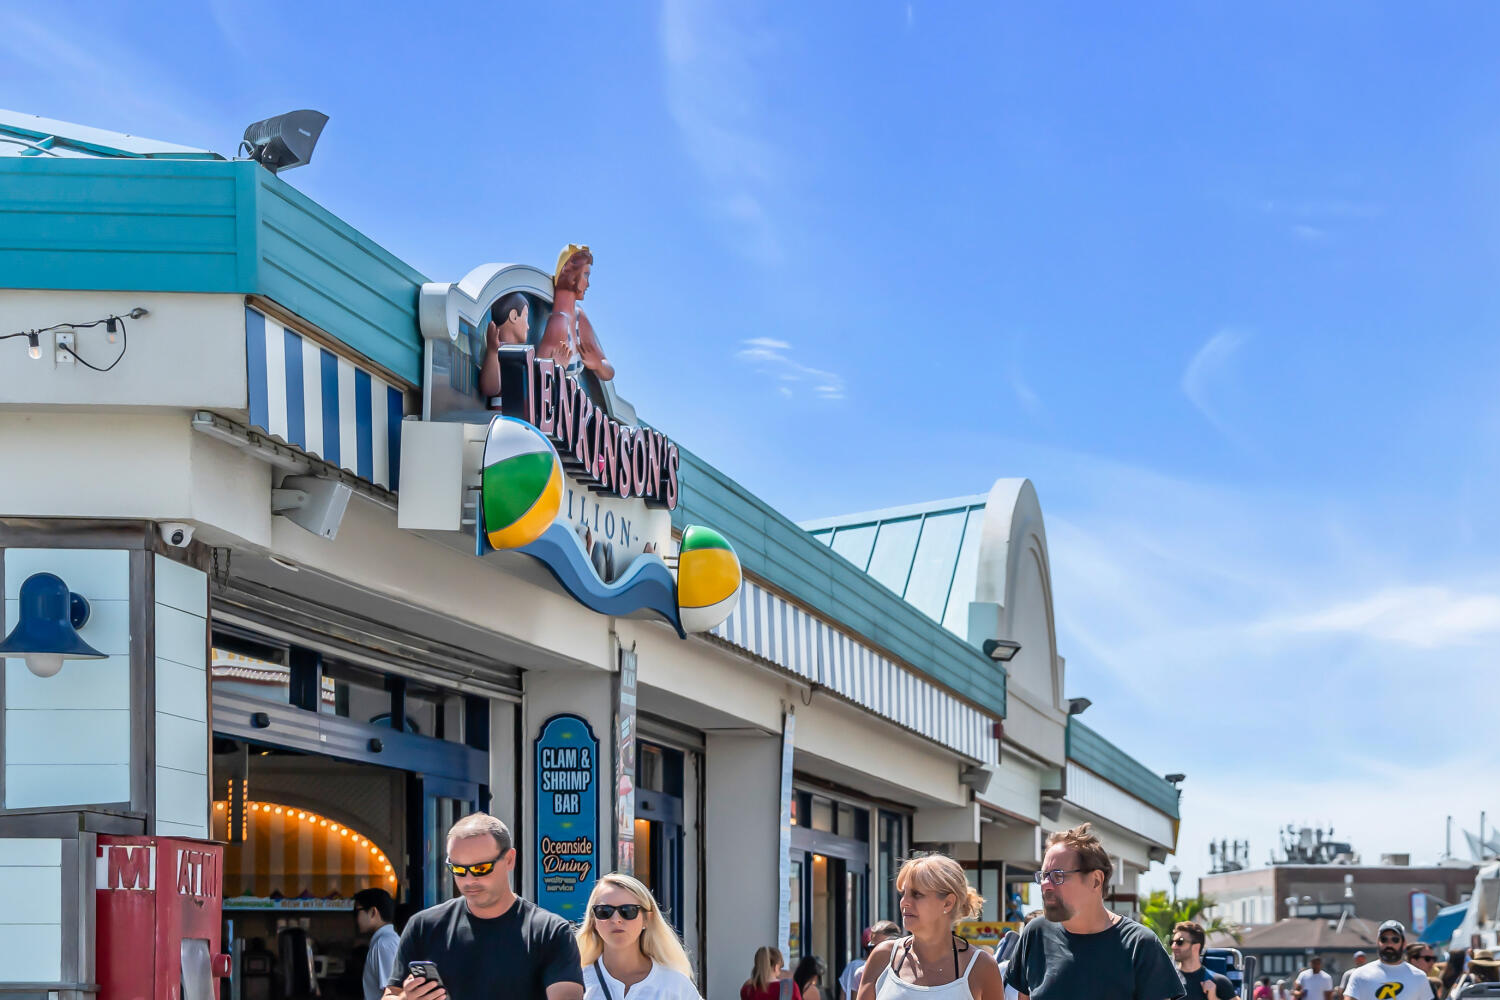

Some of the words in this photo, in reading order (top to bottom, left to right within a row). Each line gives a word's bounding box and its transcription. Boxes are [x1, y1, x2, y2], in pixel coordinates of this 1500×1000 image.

[500, 345, 679, 511] JENKINSON'S
[543, 749, 577, 768] CLAM
[581, 749, 590, 768] &
[543, 771, 590, 790] SHRIMP
[555, 794, 579, 813] BAR
[542, 837, 592, 854] Oceanside
[177, 849, 217, 897] ATM
[543, 855, 591, 881] Dining
